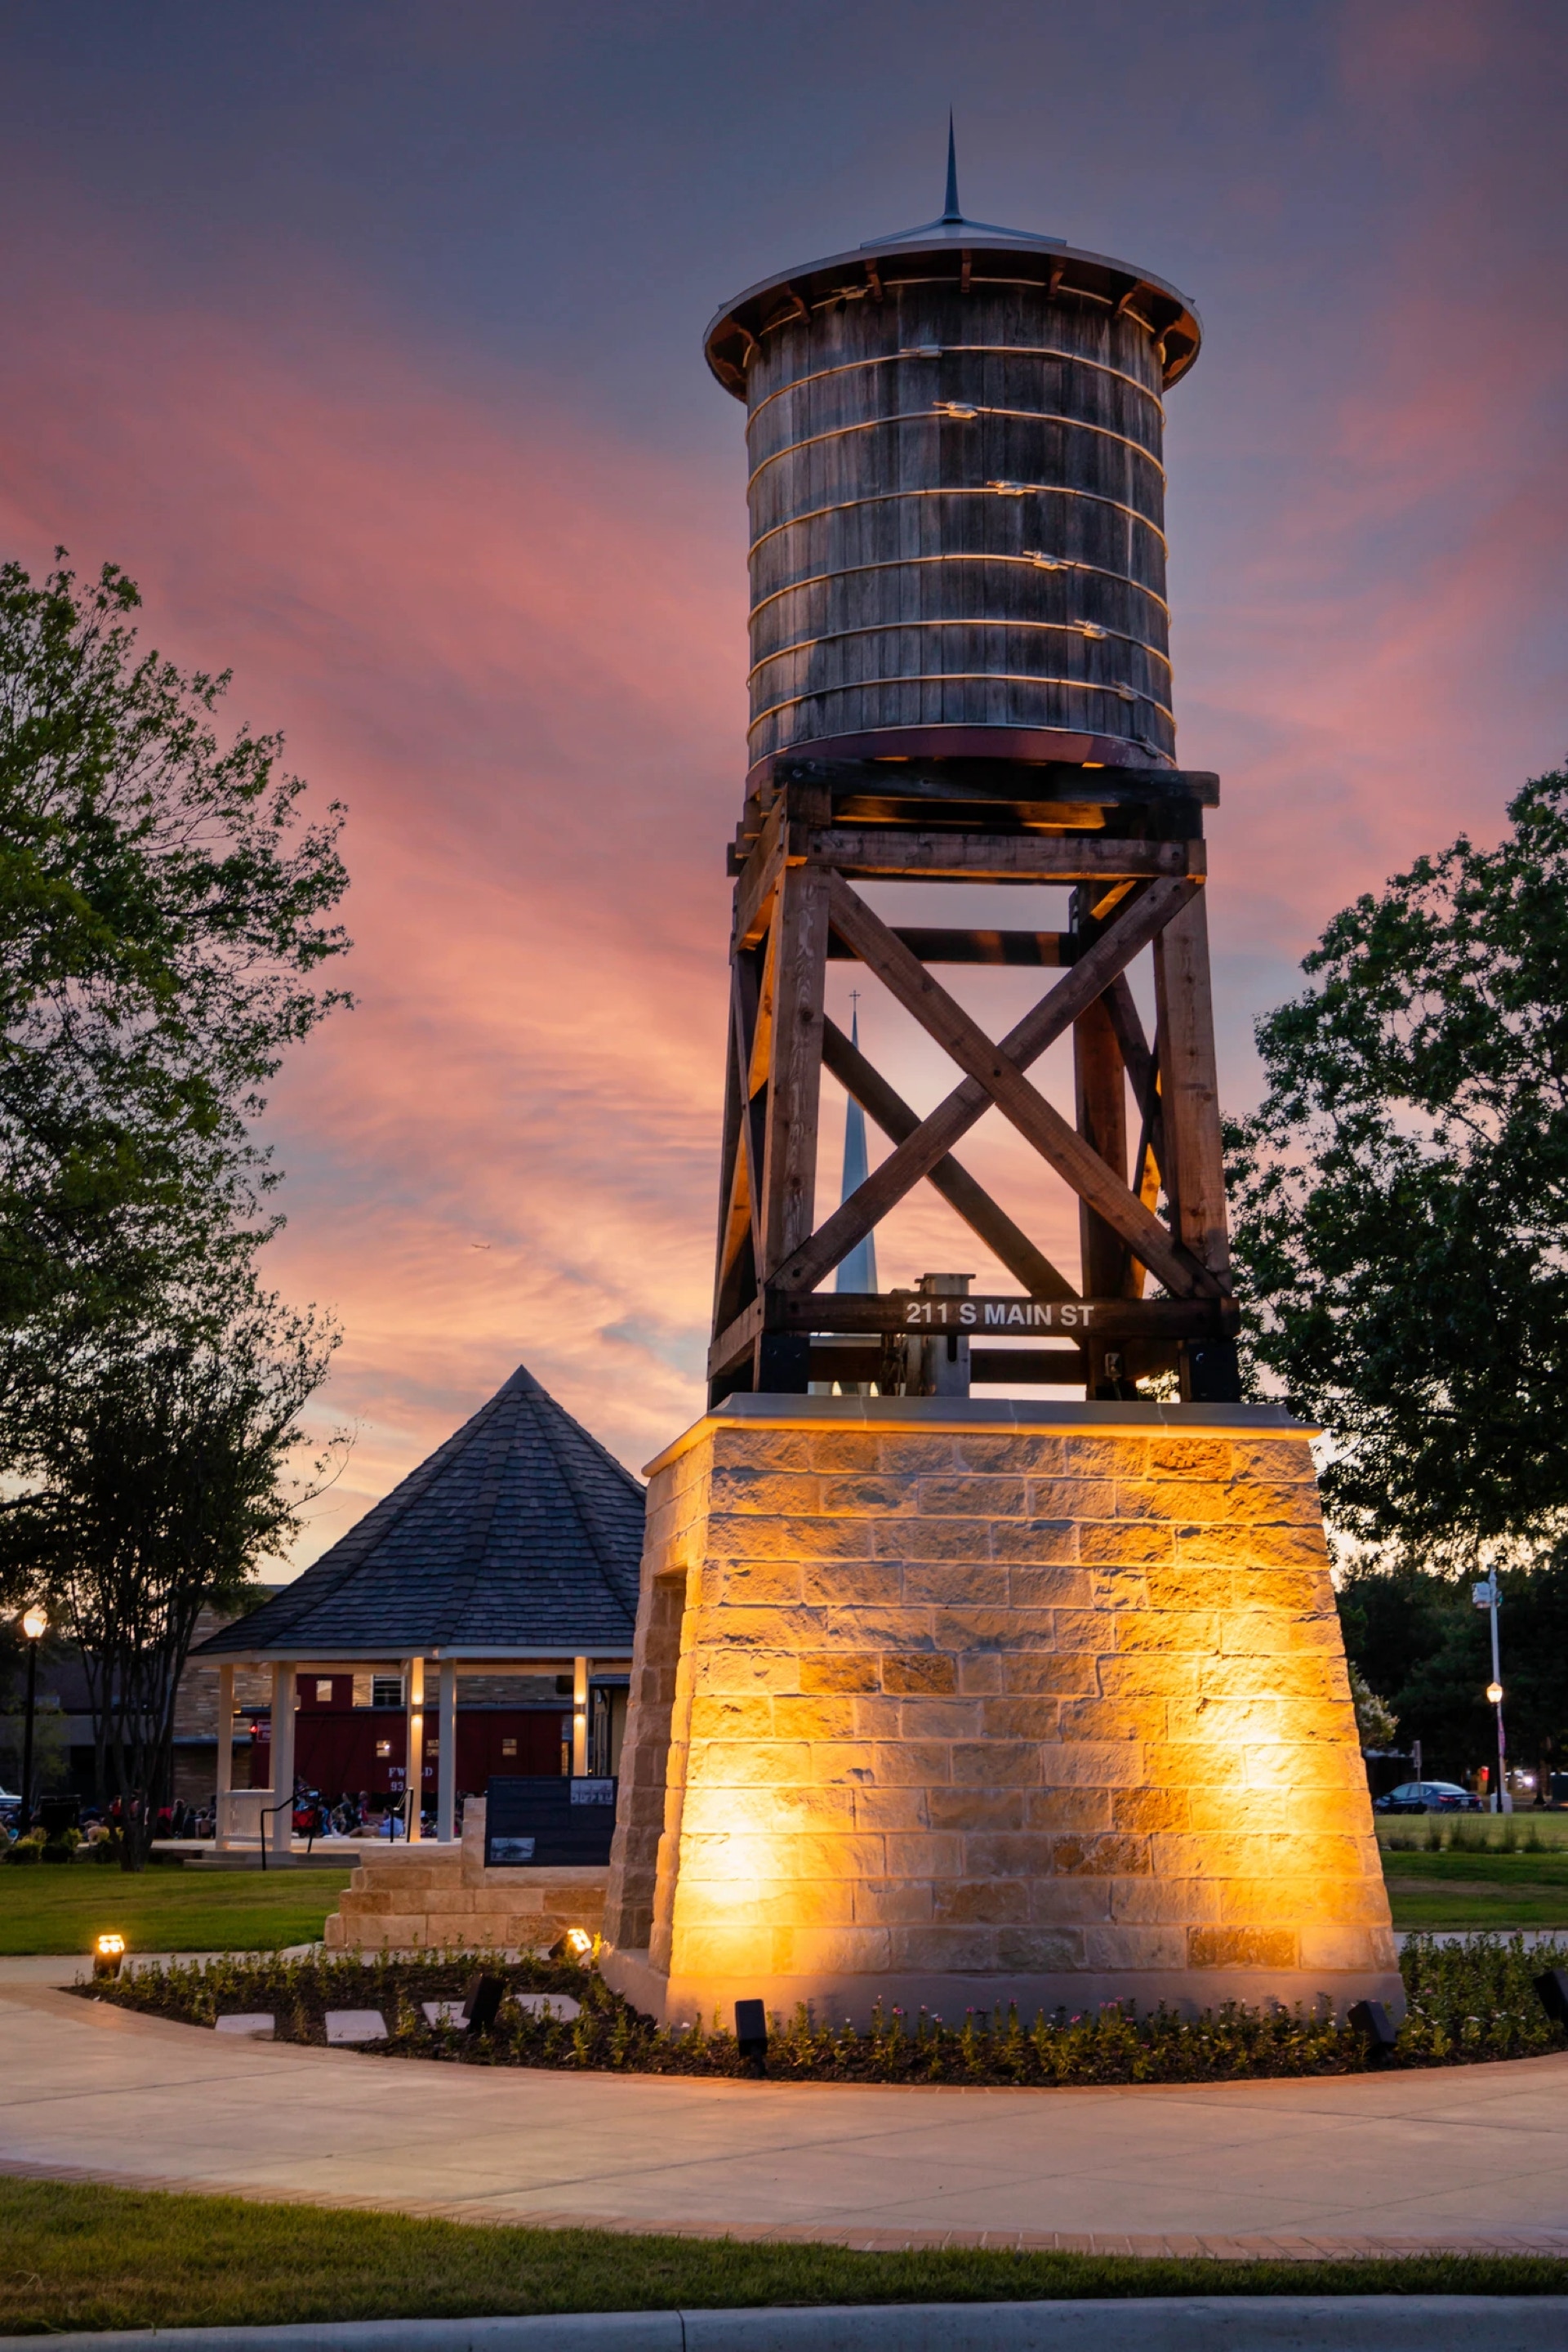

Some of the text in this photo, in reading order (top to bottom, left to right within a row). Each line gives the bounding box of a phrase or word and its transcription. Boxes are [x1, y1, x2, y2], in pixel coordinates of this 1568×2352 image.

[906, 1302, 1094, 1326] 211 S MAIN ST
